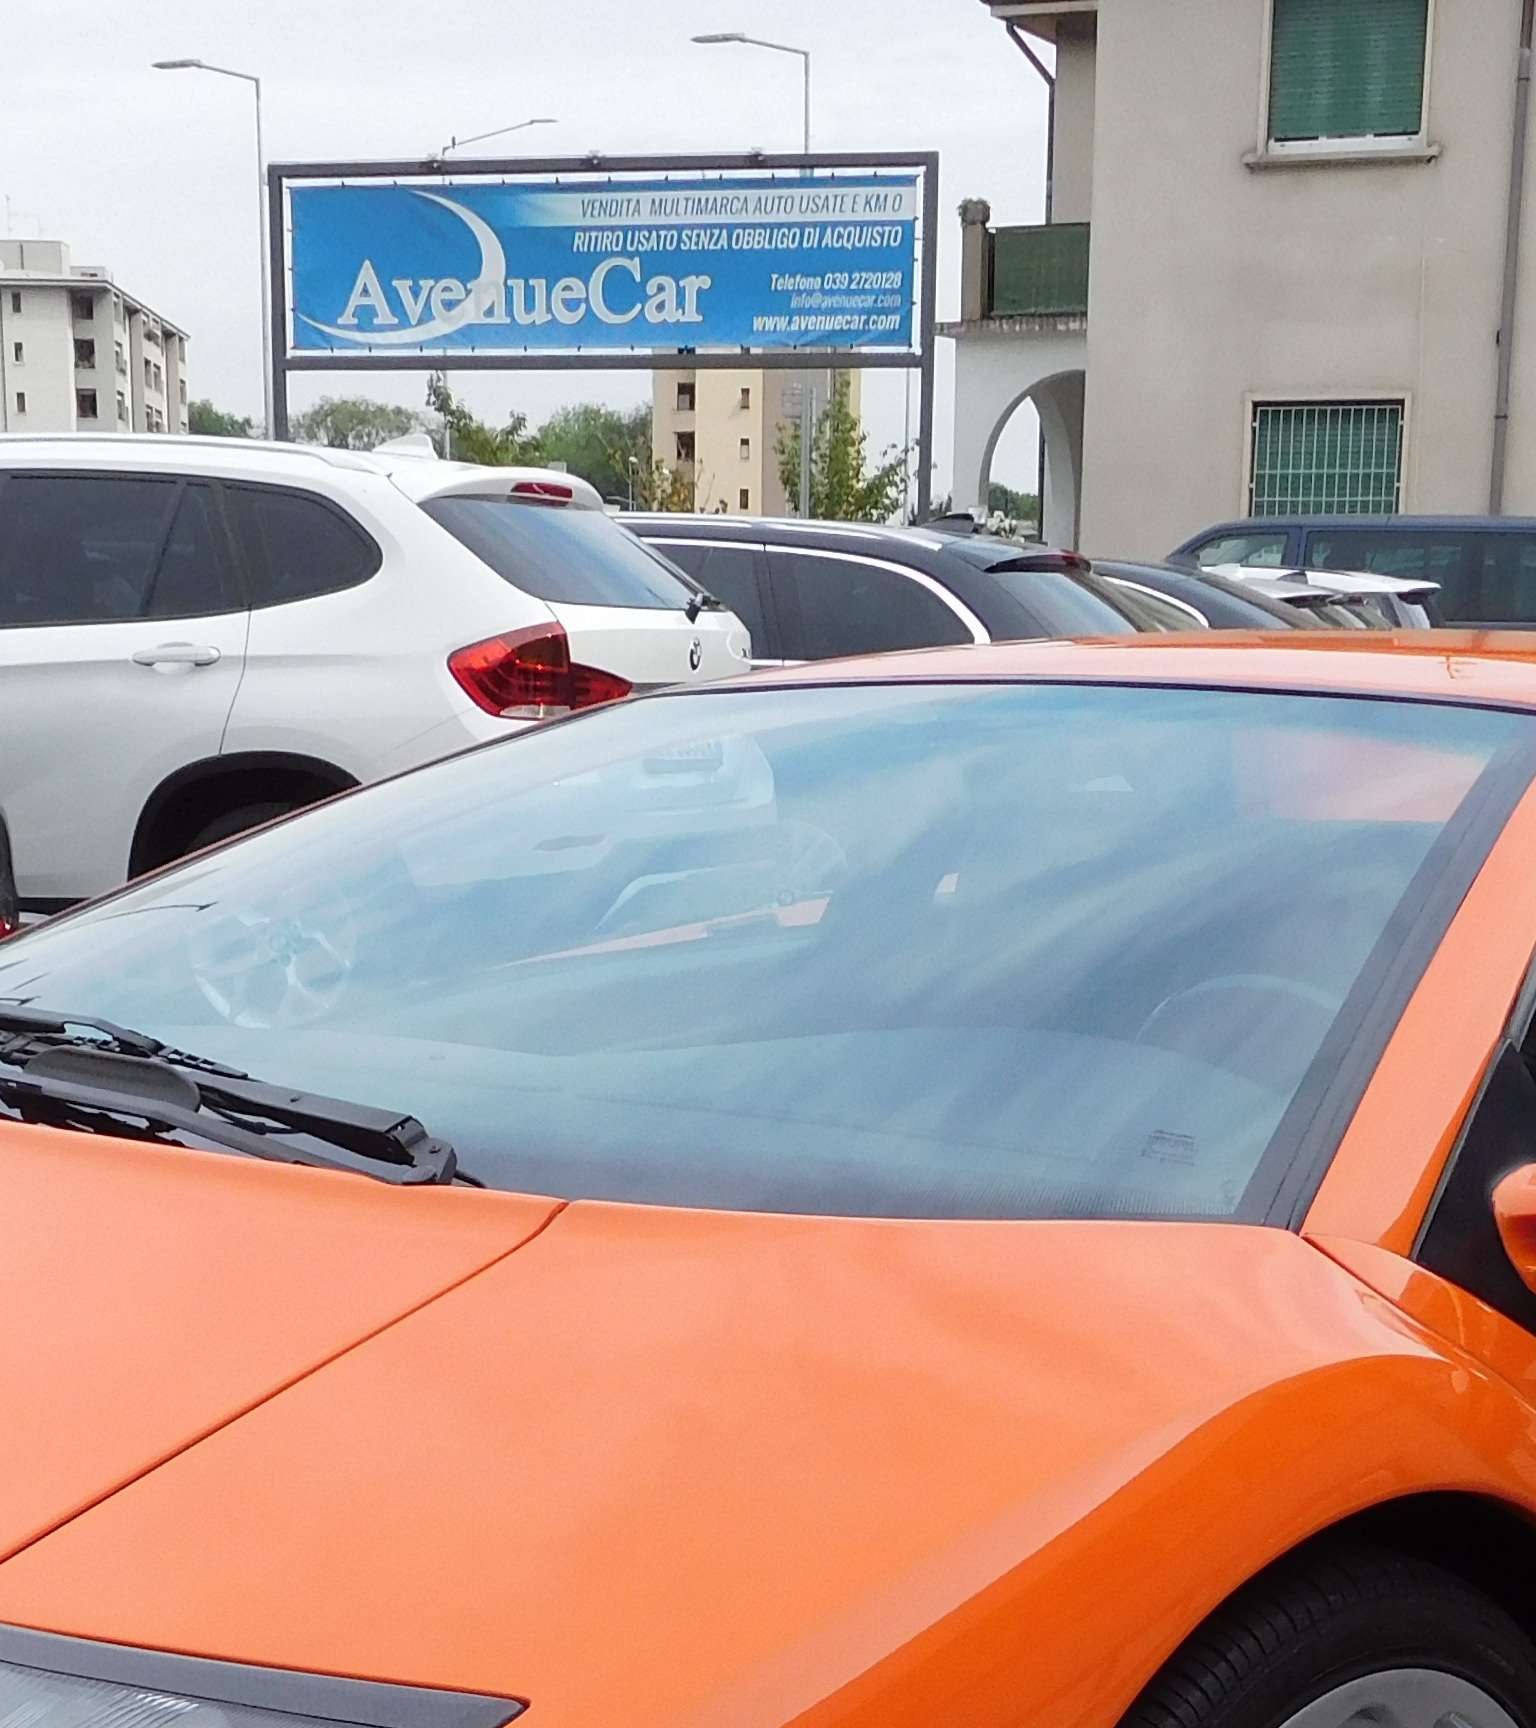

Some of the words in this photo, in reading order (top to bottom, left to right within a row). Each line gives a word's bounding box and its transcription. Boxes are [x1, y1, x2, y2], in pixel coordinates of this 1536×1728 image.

[581, 199, 641, 218] VENDITA
[649, 196, 749, 217] MULTIMARCA
[753, 195, 794, 215] AUTO
[798, 194, 849, 214] USATE
[851, 194, 861, 213] E
[864, 193, 888, 213] KM
[573, 231, 623, 252] RITIRO
[627, 230, 677, 251] USATO
[680, 229, 728, 250] SENZA
[732, 228, 800, 249] OBBLIGO
[803, 227, 819, 248] DI
[822, 226, 902, 250] ACQUISTO
[337, 256, 712, 326] AvenueCar
[770, 273, 821, 291] Telefono
[823, 272, 848, 290] 039
[850, 271, 903, 289] 2720128
[752, 314, 901, 331] www.avenuecar.com
